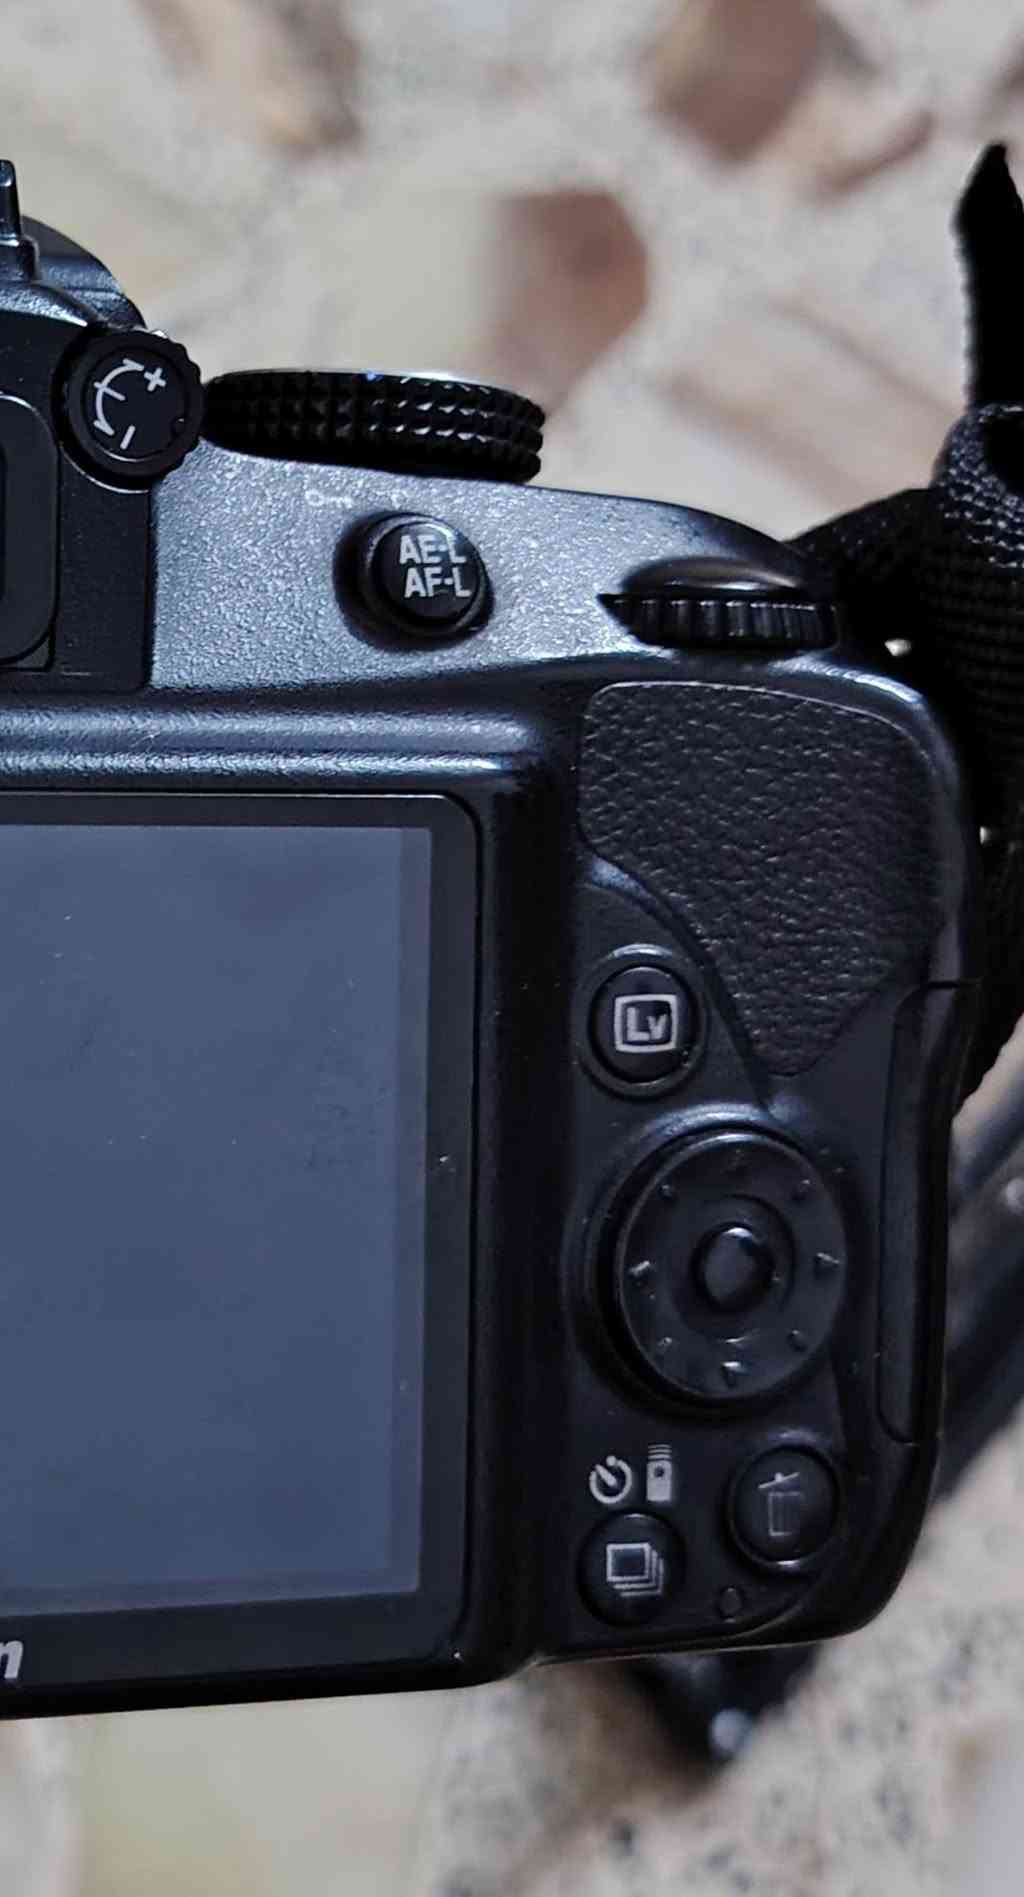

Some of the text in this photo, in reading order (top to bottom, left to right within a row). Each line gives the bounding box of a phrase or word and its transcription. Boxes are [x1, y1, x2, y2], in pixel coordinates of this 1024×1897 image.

[399, 534, 467, 564] AE-L
[404, 566, 472, 598] AF-L
[626, 1006, 668, 1042] Lv
